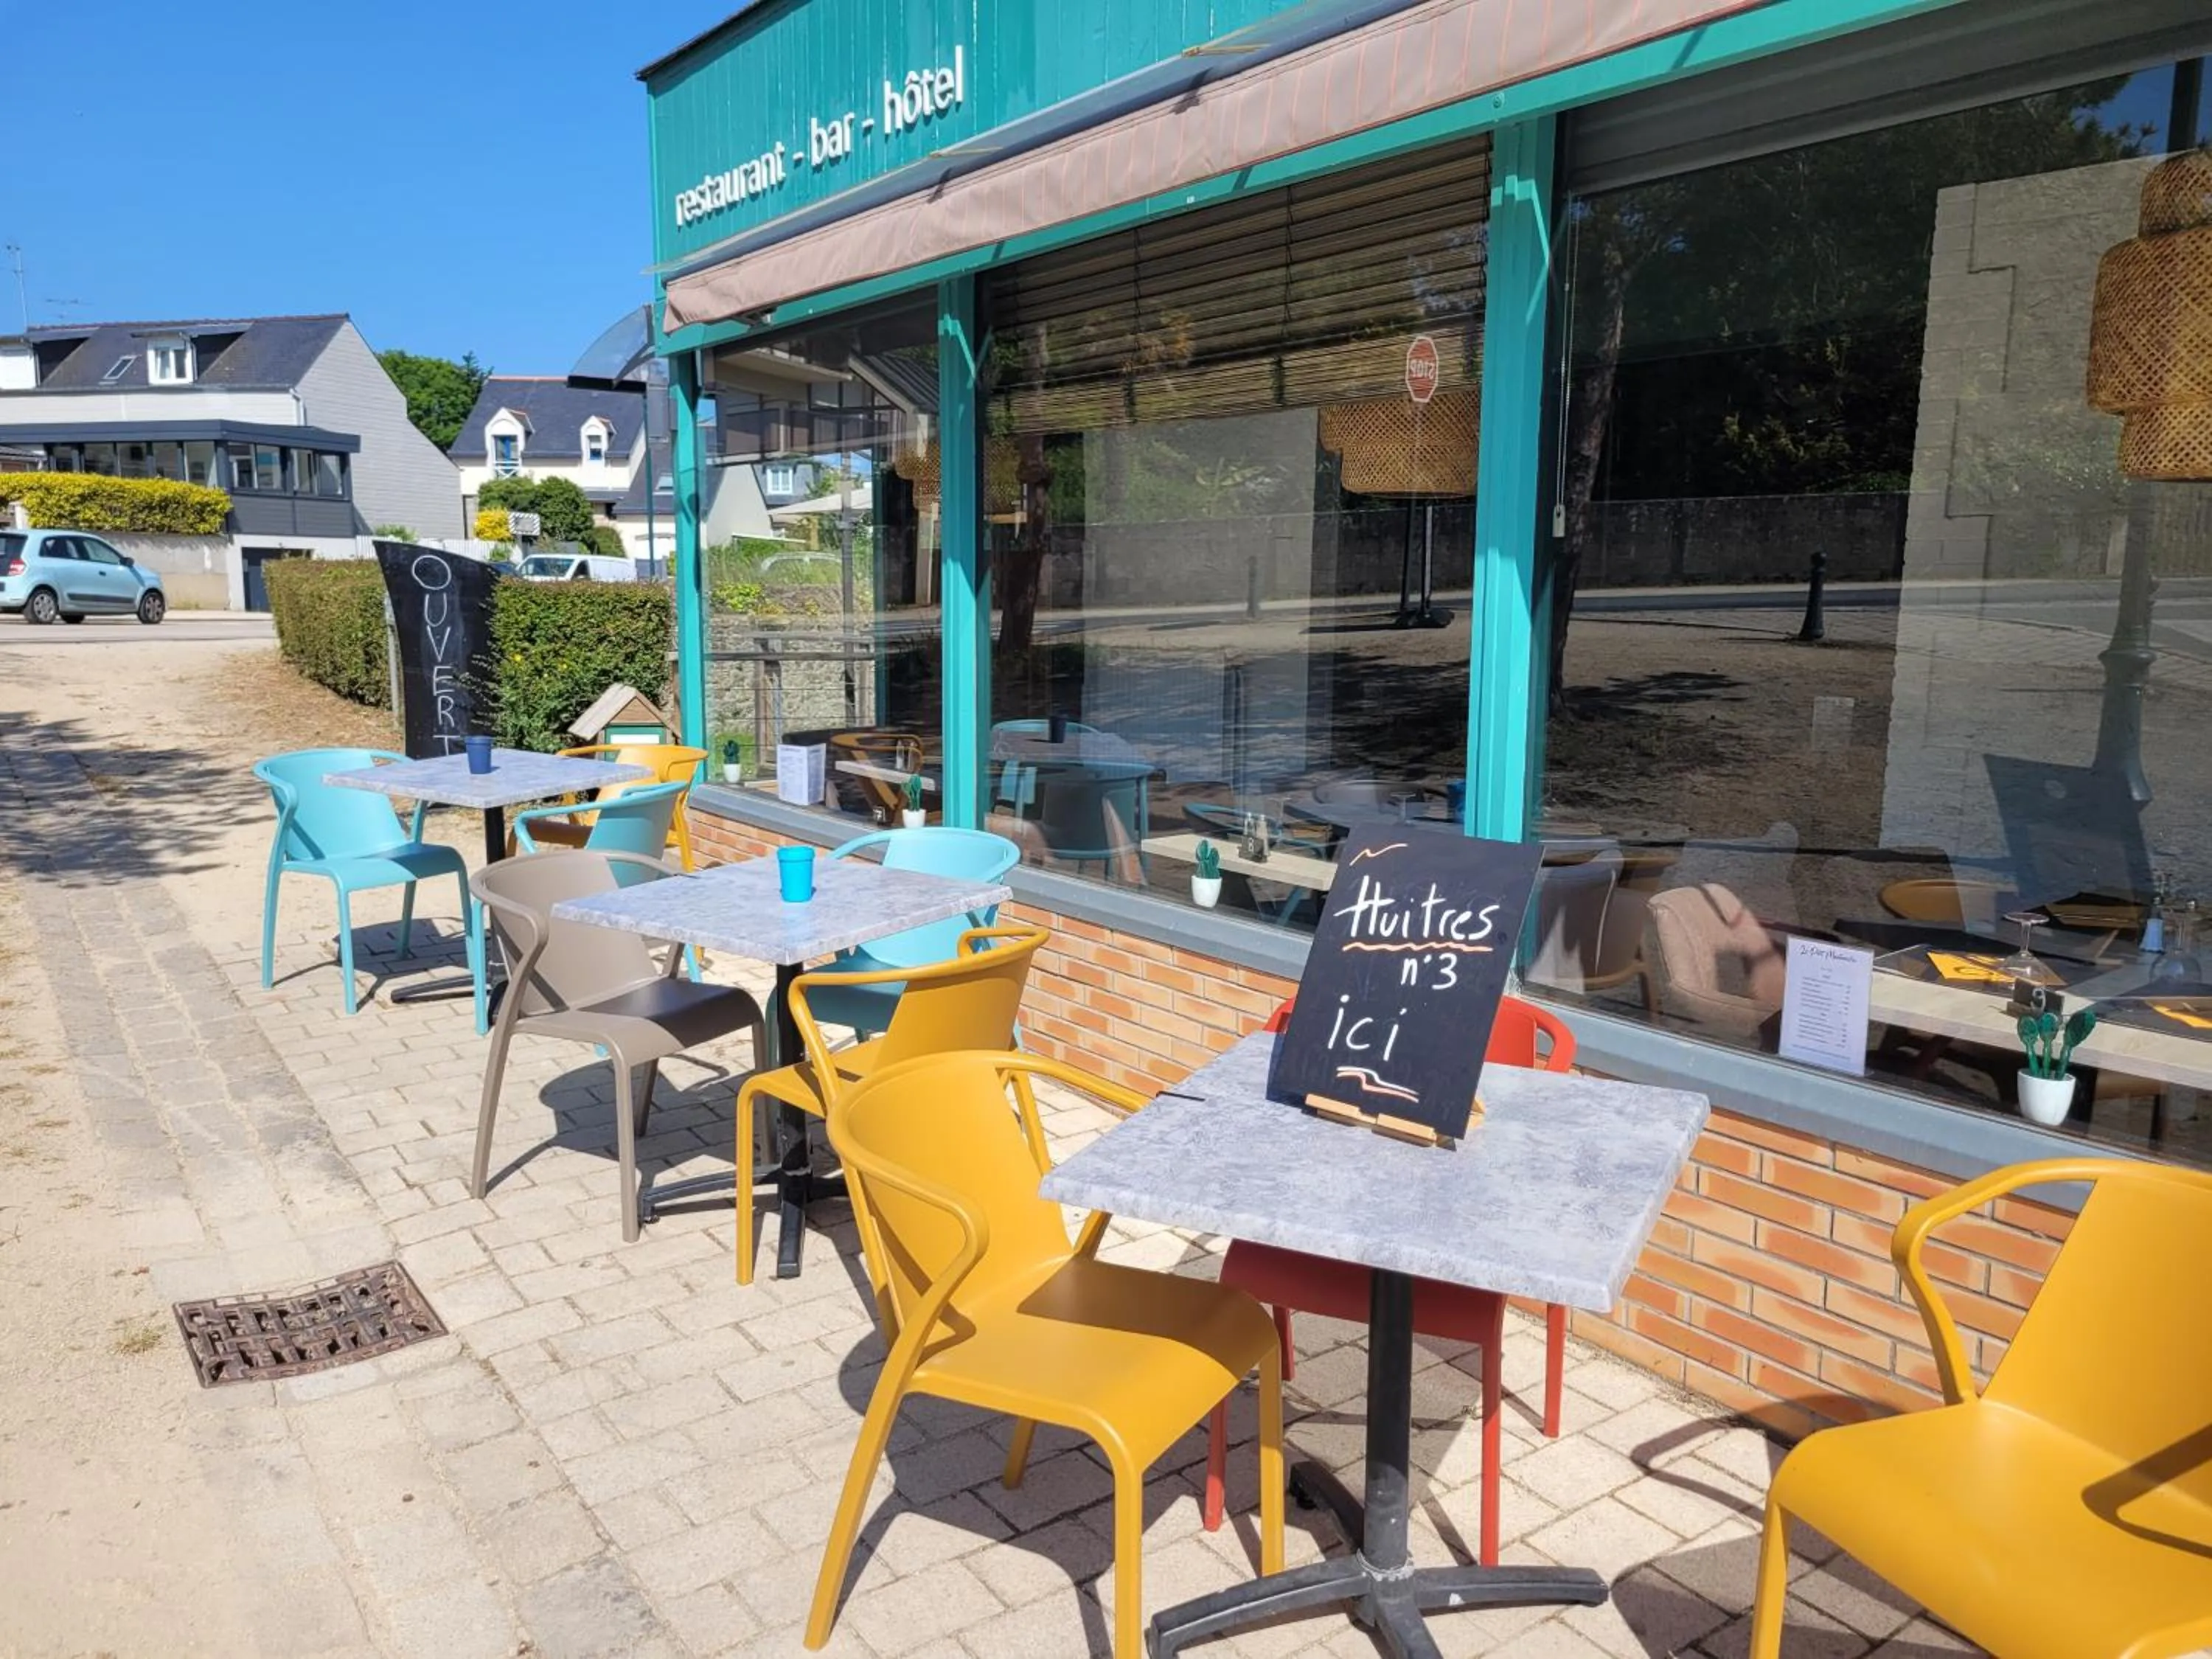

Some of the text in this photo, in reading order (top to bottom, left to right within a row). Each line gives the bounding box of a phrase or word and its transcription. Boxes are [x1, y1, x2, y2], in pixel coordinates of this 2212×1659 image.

[675, 141, 786, 226] restaurant
[810, 111, 855, 167] bar
[884, 44, 964, 134] hôtel
[411, 554, 461, 757] OUVERT
[1333, 874, 1500, 941] Huitres
[1328, 994, 1408, 1062] ici
